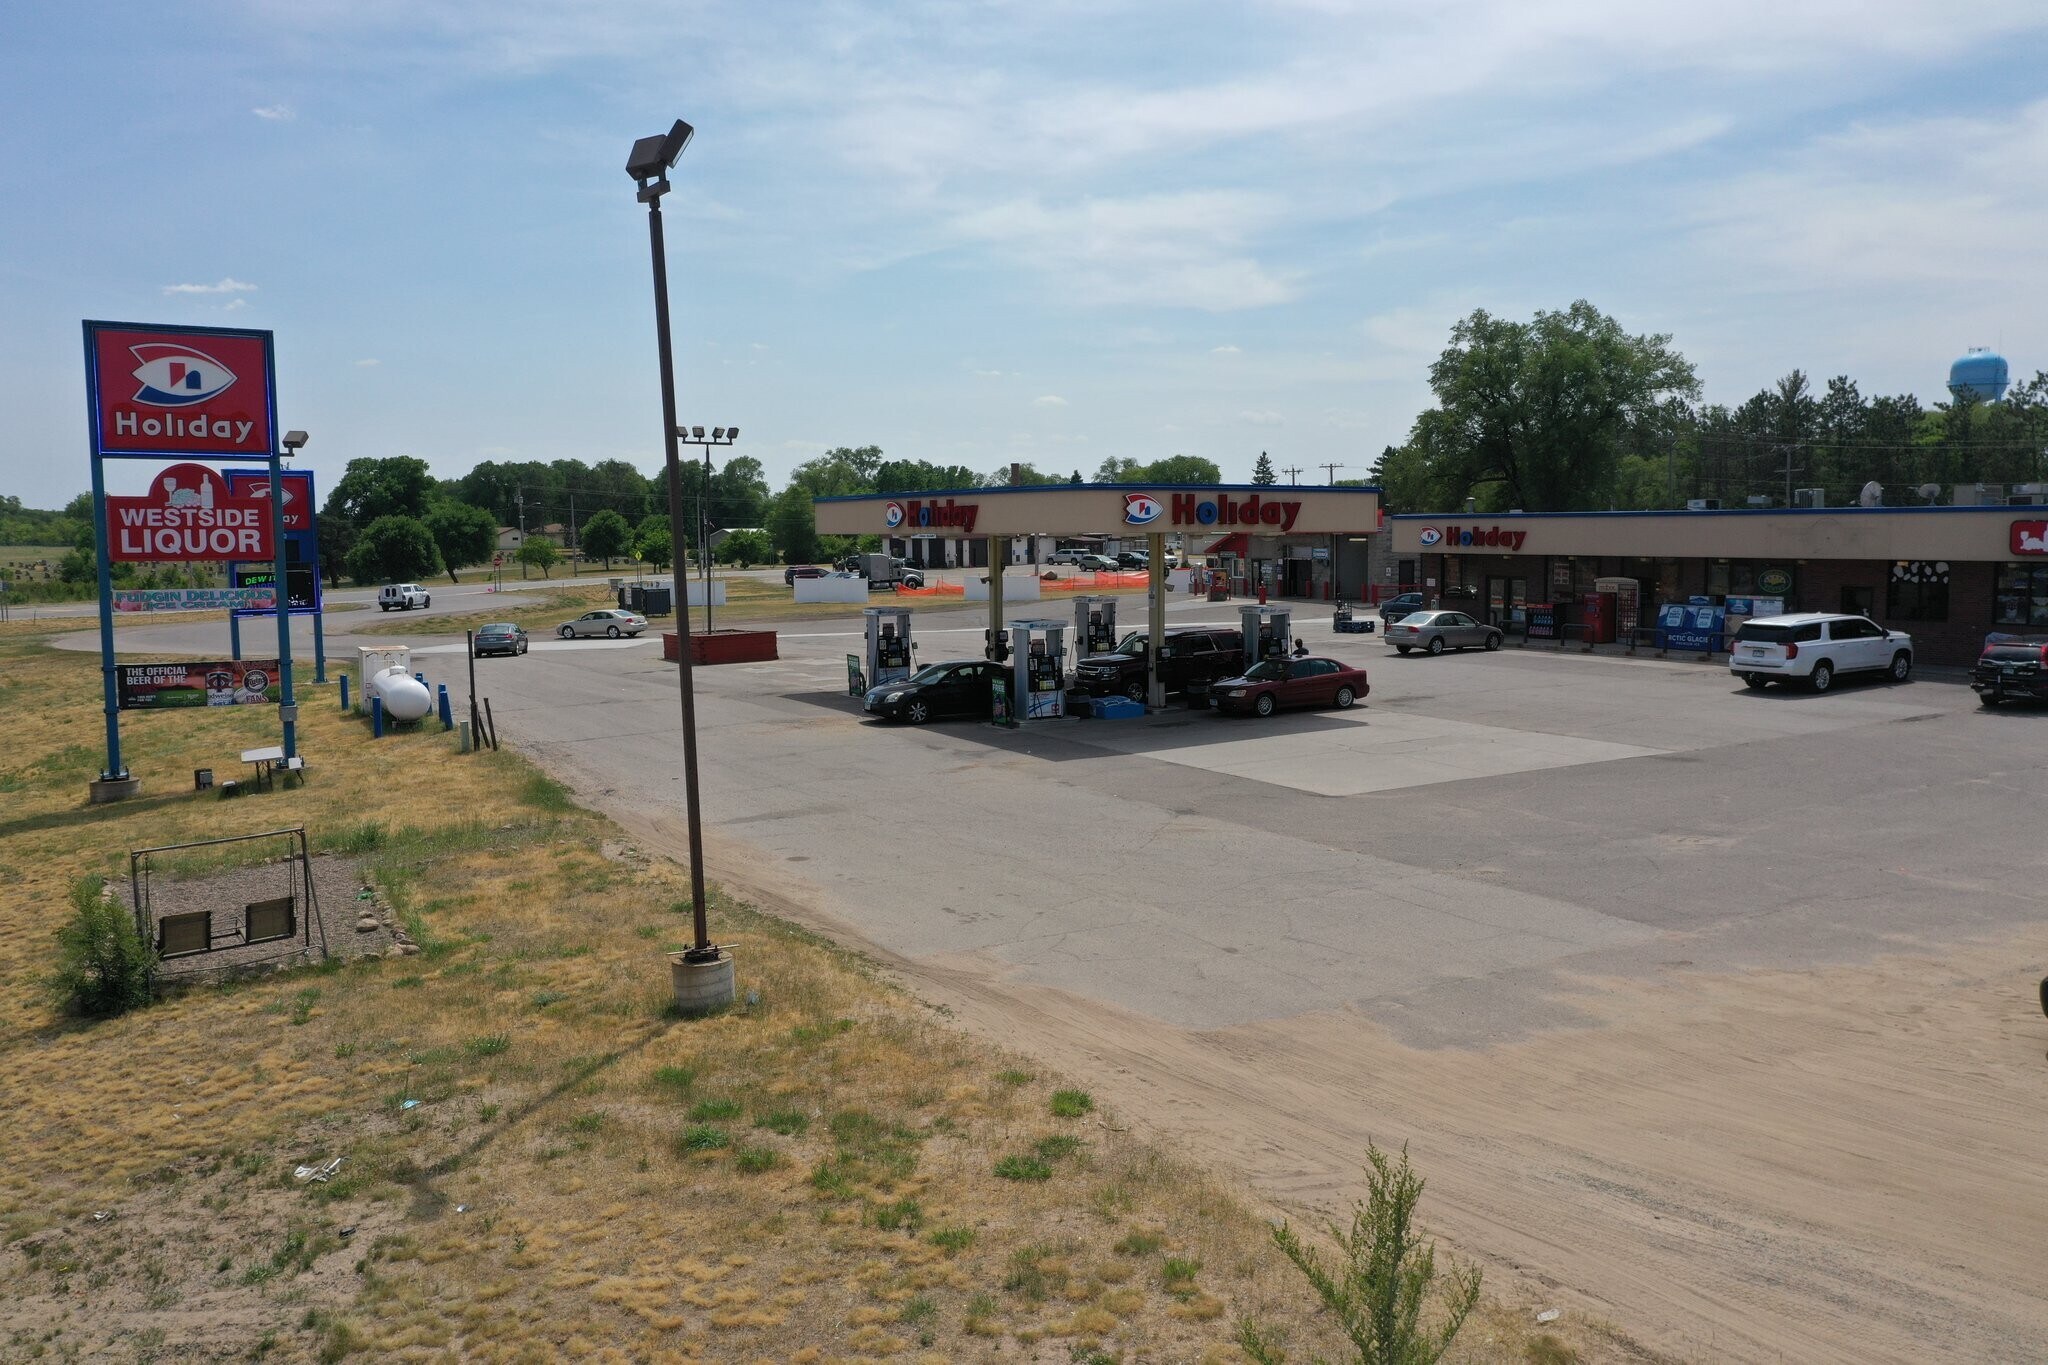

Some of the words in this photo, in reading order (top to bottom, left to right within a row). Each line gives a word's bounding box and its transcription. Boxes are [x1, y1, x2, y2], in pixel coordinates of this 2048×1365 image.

[115, 411, 253, 444] Holiday
[119, 508, 260, 527] WESTSIDE
[906, 498, 979, 533] Holiday
[1171, 493, 1302, 532] Holiday
[120, 528, 261, 555] LIQUOR
[1446, 526, 1527, 551] Holiday
[245, 575, 267, 586] DEW
[114, 591, 182, 603] FUDGIN
[186, 589, 273, 601] DELICIOUS
[148, 601, 177, 610] ICE
[181, 601, 245, 609] CREAM
[1667, 634, 1687, 642] RCTIC
[1686, 635, 1713, 643] GLACIE
[126, 667, 145, 676] THE
[146, 666, 188, 676] OFFICIAL
[126, 676, 151, 686] BEER
[153, 676, 166, 685] OF
[168, 675, 187, 684] THE
[992, 683, 1006, 693] FREE
[245, 694, 269, 704] FANS
